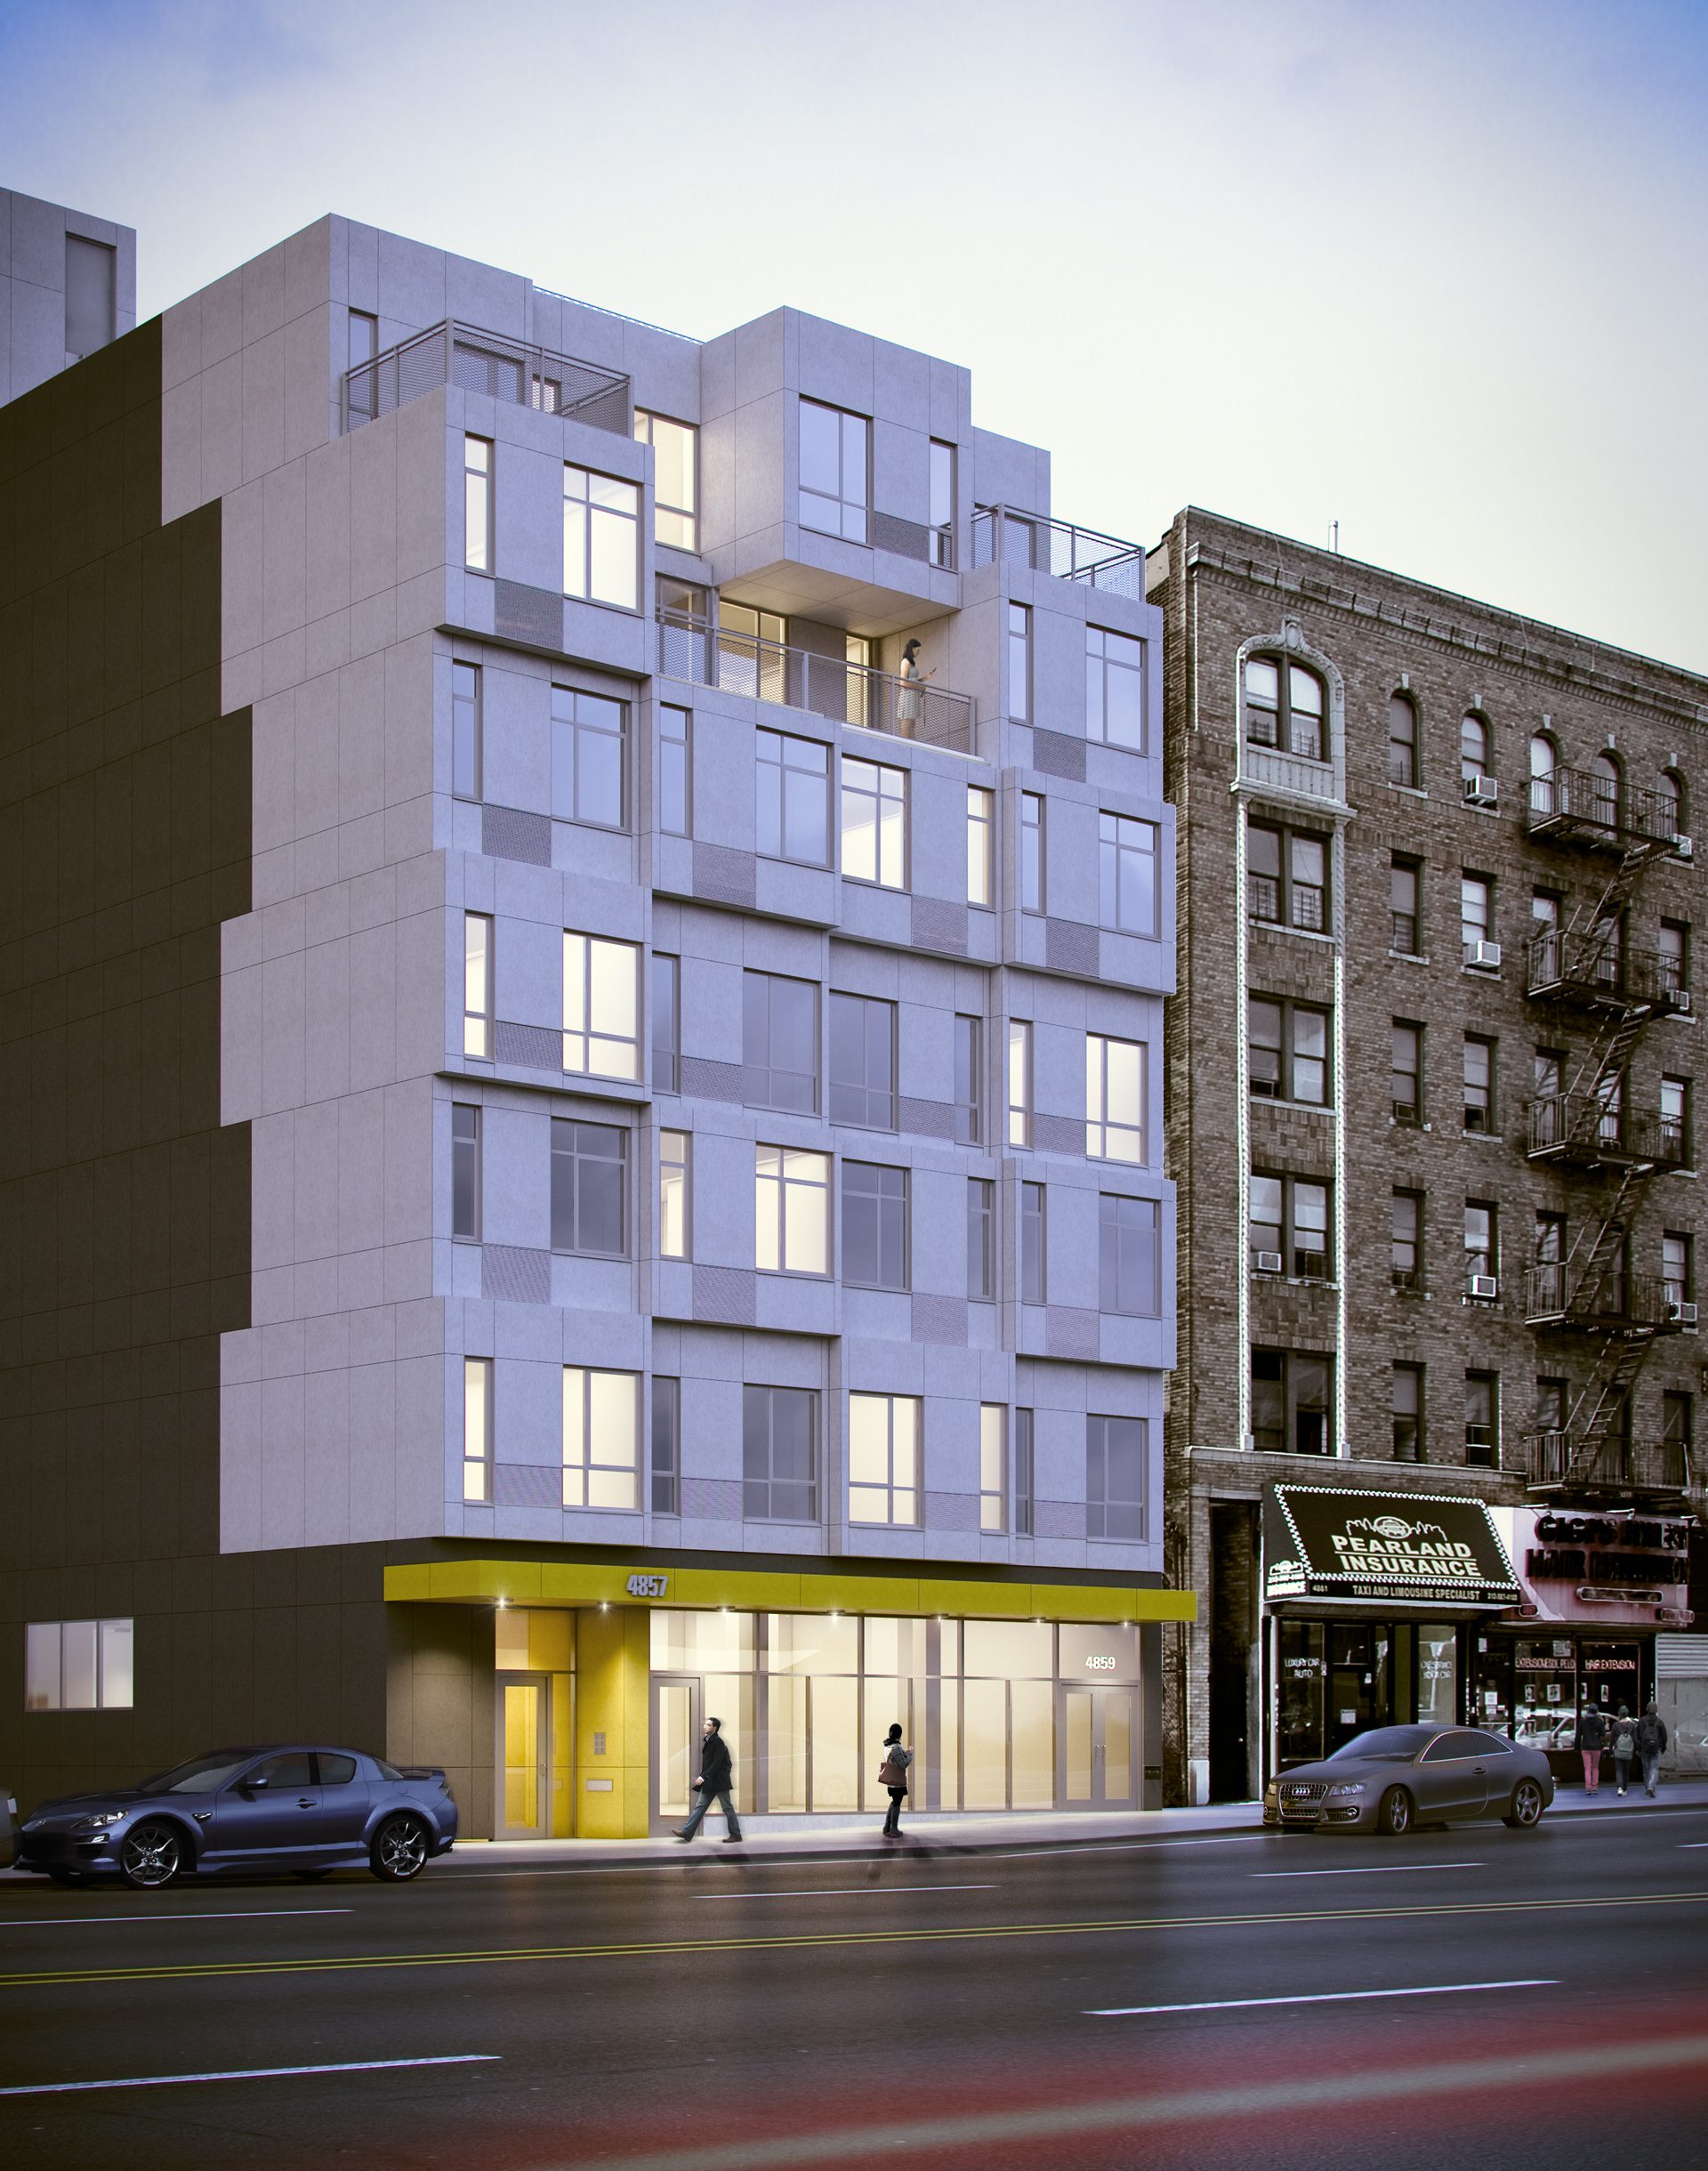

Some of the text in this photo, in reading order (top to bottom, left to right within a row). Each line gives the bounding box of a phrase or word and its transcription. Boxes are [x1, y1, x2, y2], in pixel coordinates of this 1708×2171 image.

[1332, 1535, 1472, 1558] PEARLAND
[1340, 1554, 1482, 1577] INSURANCE
[626, 1574, 669, 1597] 4857
[1352, 1586, 1480, 1601] TAXI AND LIMOUSINE SPECIALIST
[1085, 1656, 1116, 1670] 4859
